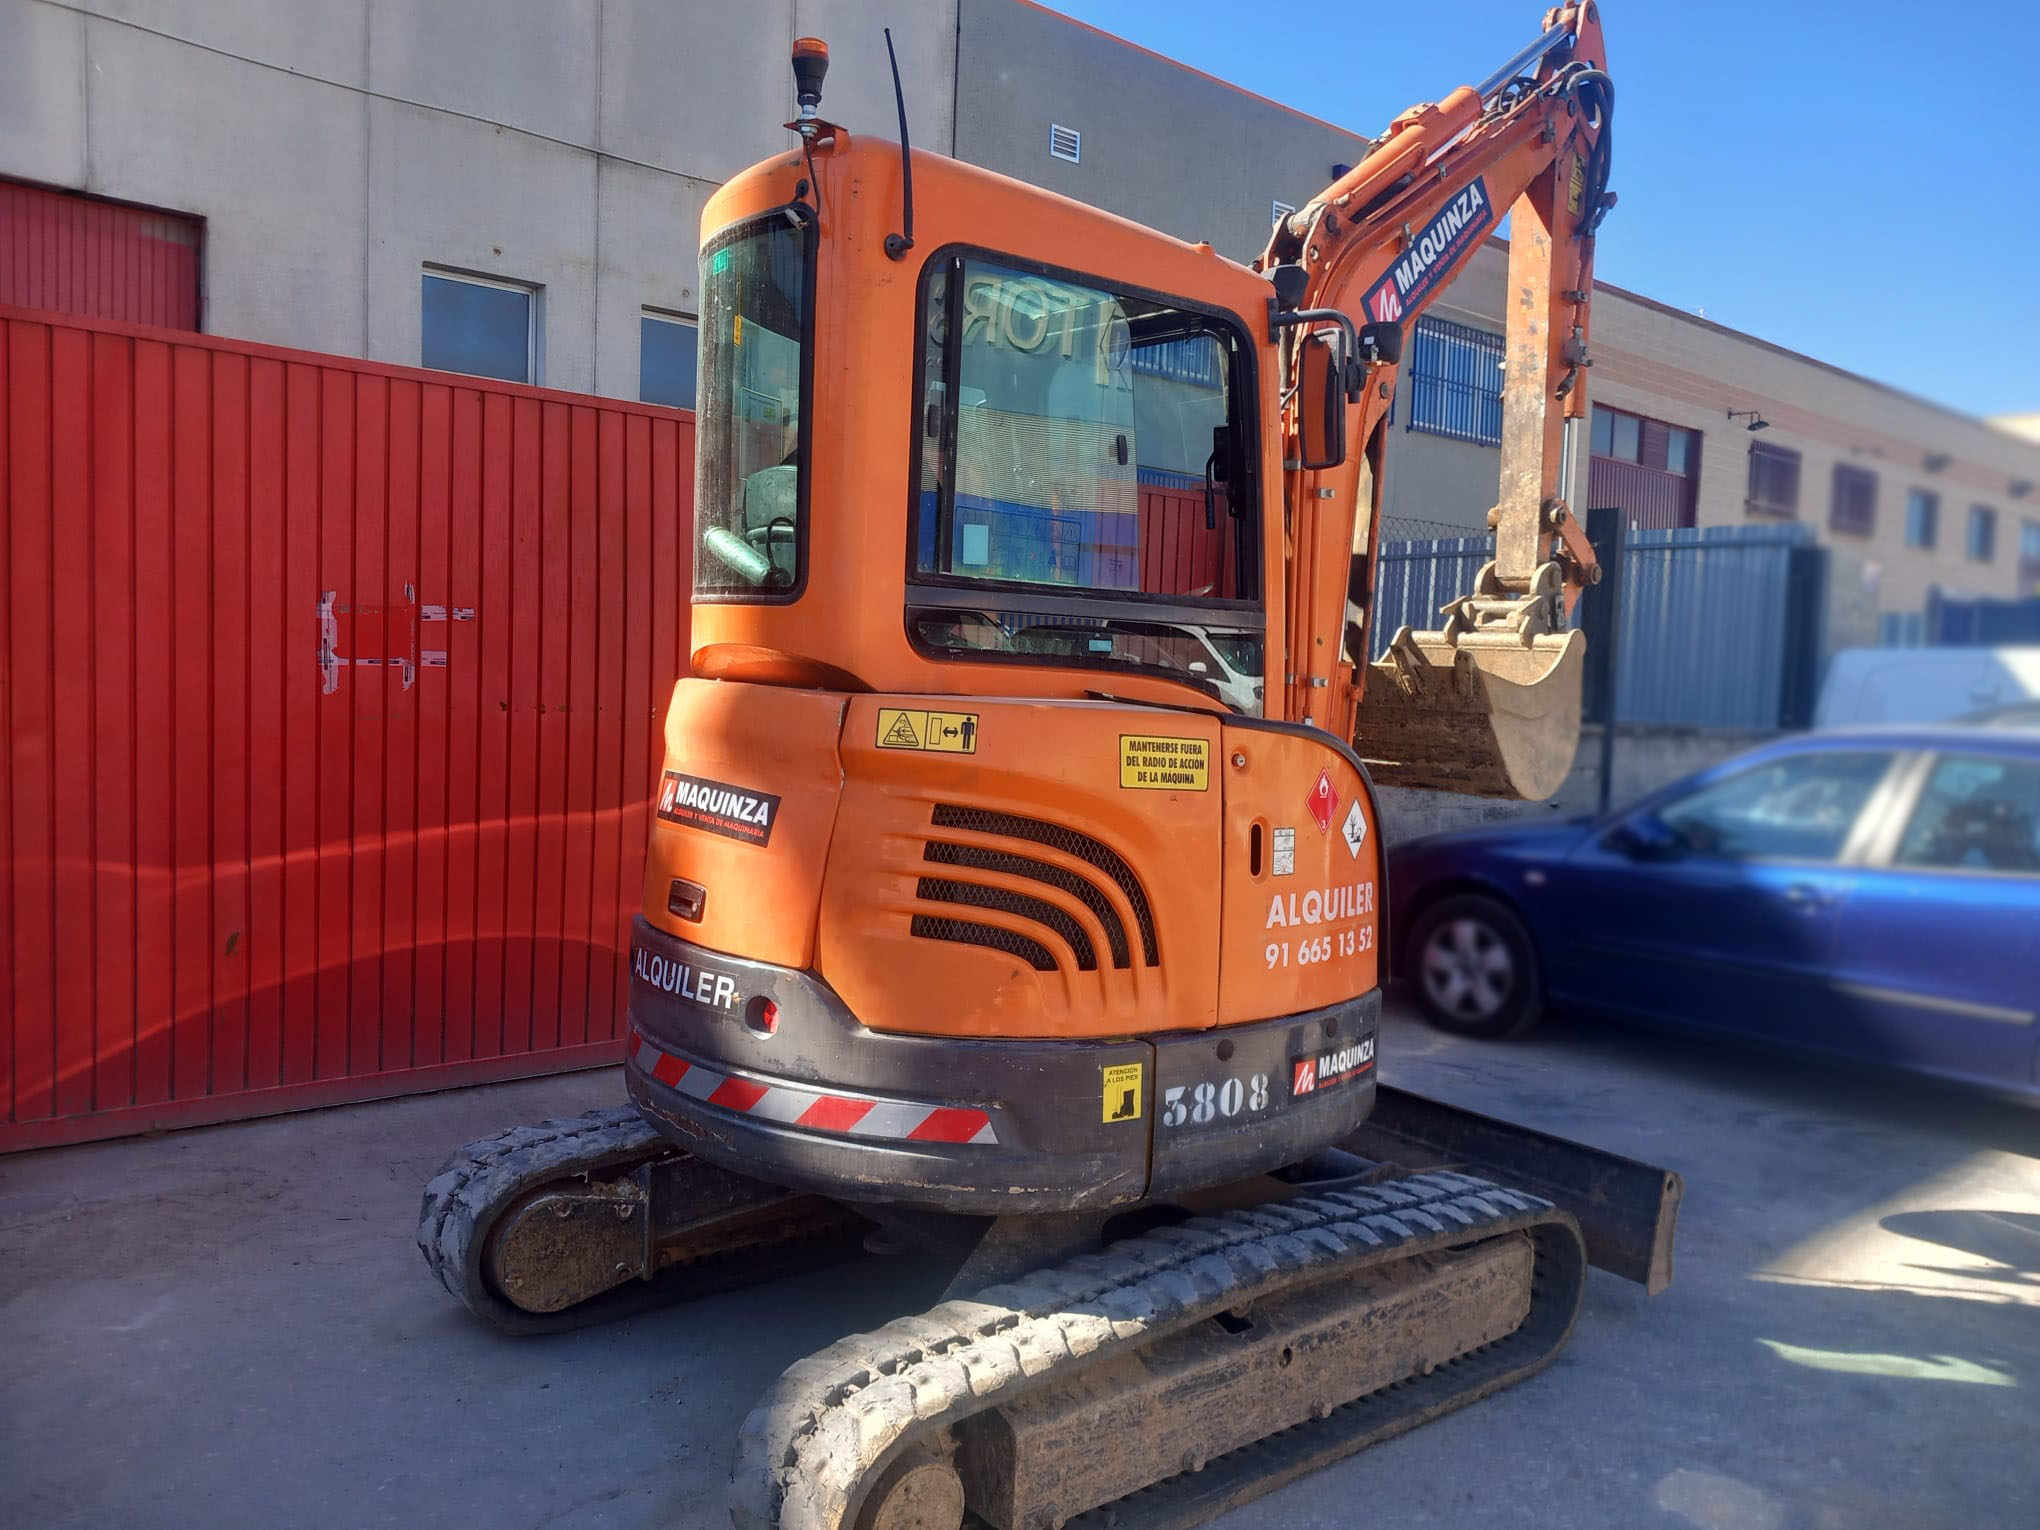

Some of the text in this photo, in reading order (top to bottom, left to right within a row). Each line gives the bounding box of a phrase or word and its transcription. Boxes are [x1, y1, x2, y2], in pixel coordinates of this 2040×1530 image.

[1395, 184, 1484, 295] MAQUINZA
[1126, 755, 1140, 767] DEL
[1142, 756, 1167, 769] RADIO
[1168, 757, 1178, 769] DE
[1129, 741, 1203, 755] MANTENERSE FUERA
[1137, 771, 1147, 783] DE
[1149, 771, 1159, 783] LA
[673, 807, 694, 819] ALQUILER
[698, 813, 715, 825] VENTA
[715, 818, 724, 827] DE
[724, 821, 765, 838] MAQUINARIA
[675, 781, 769, 826] MAQUINZA
[1266, 882, 1373, 929] ALQUILER
[1265, 925, 1373, 970] 91 665 13 52
[635, 947, 735, 1009] ALQUILER
[1319, 1038, 1374, 1079] MAQUINZA
[1112, 1076, 1125, 1084] LOS
